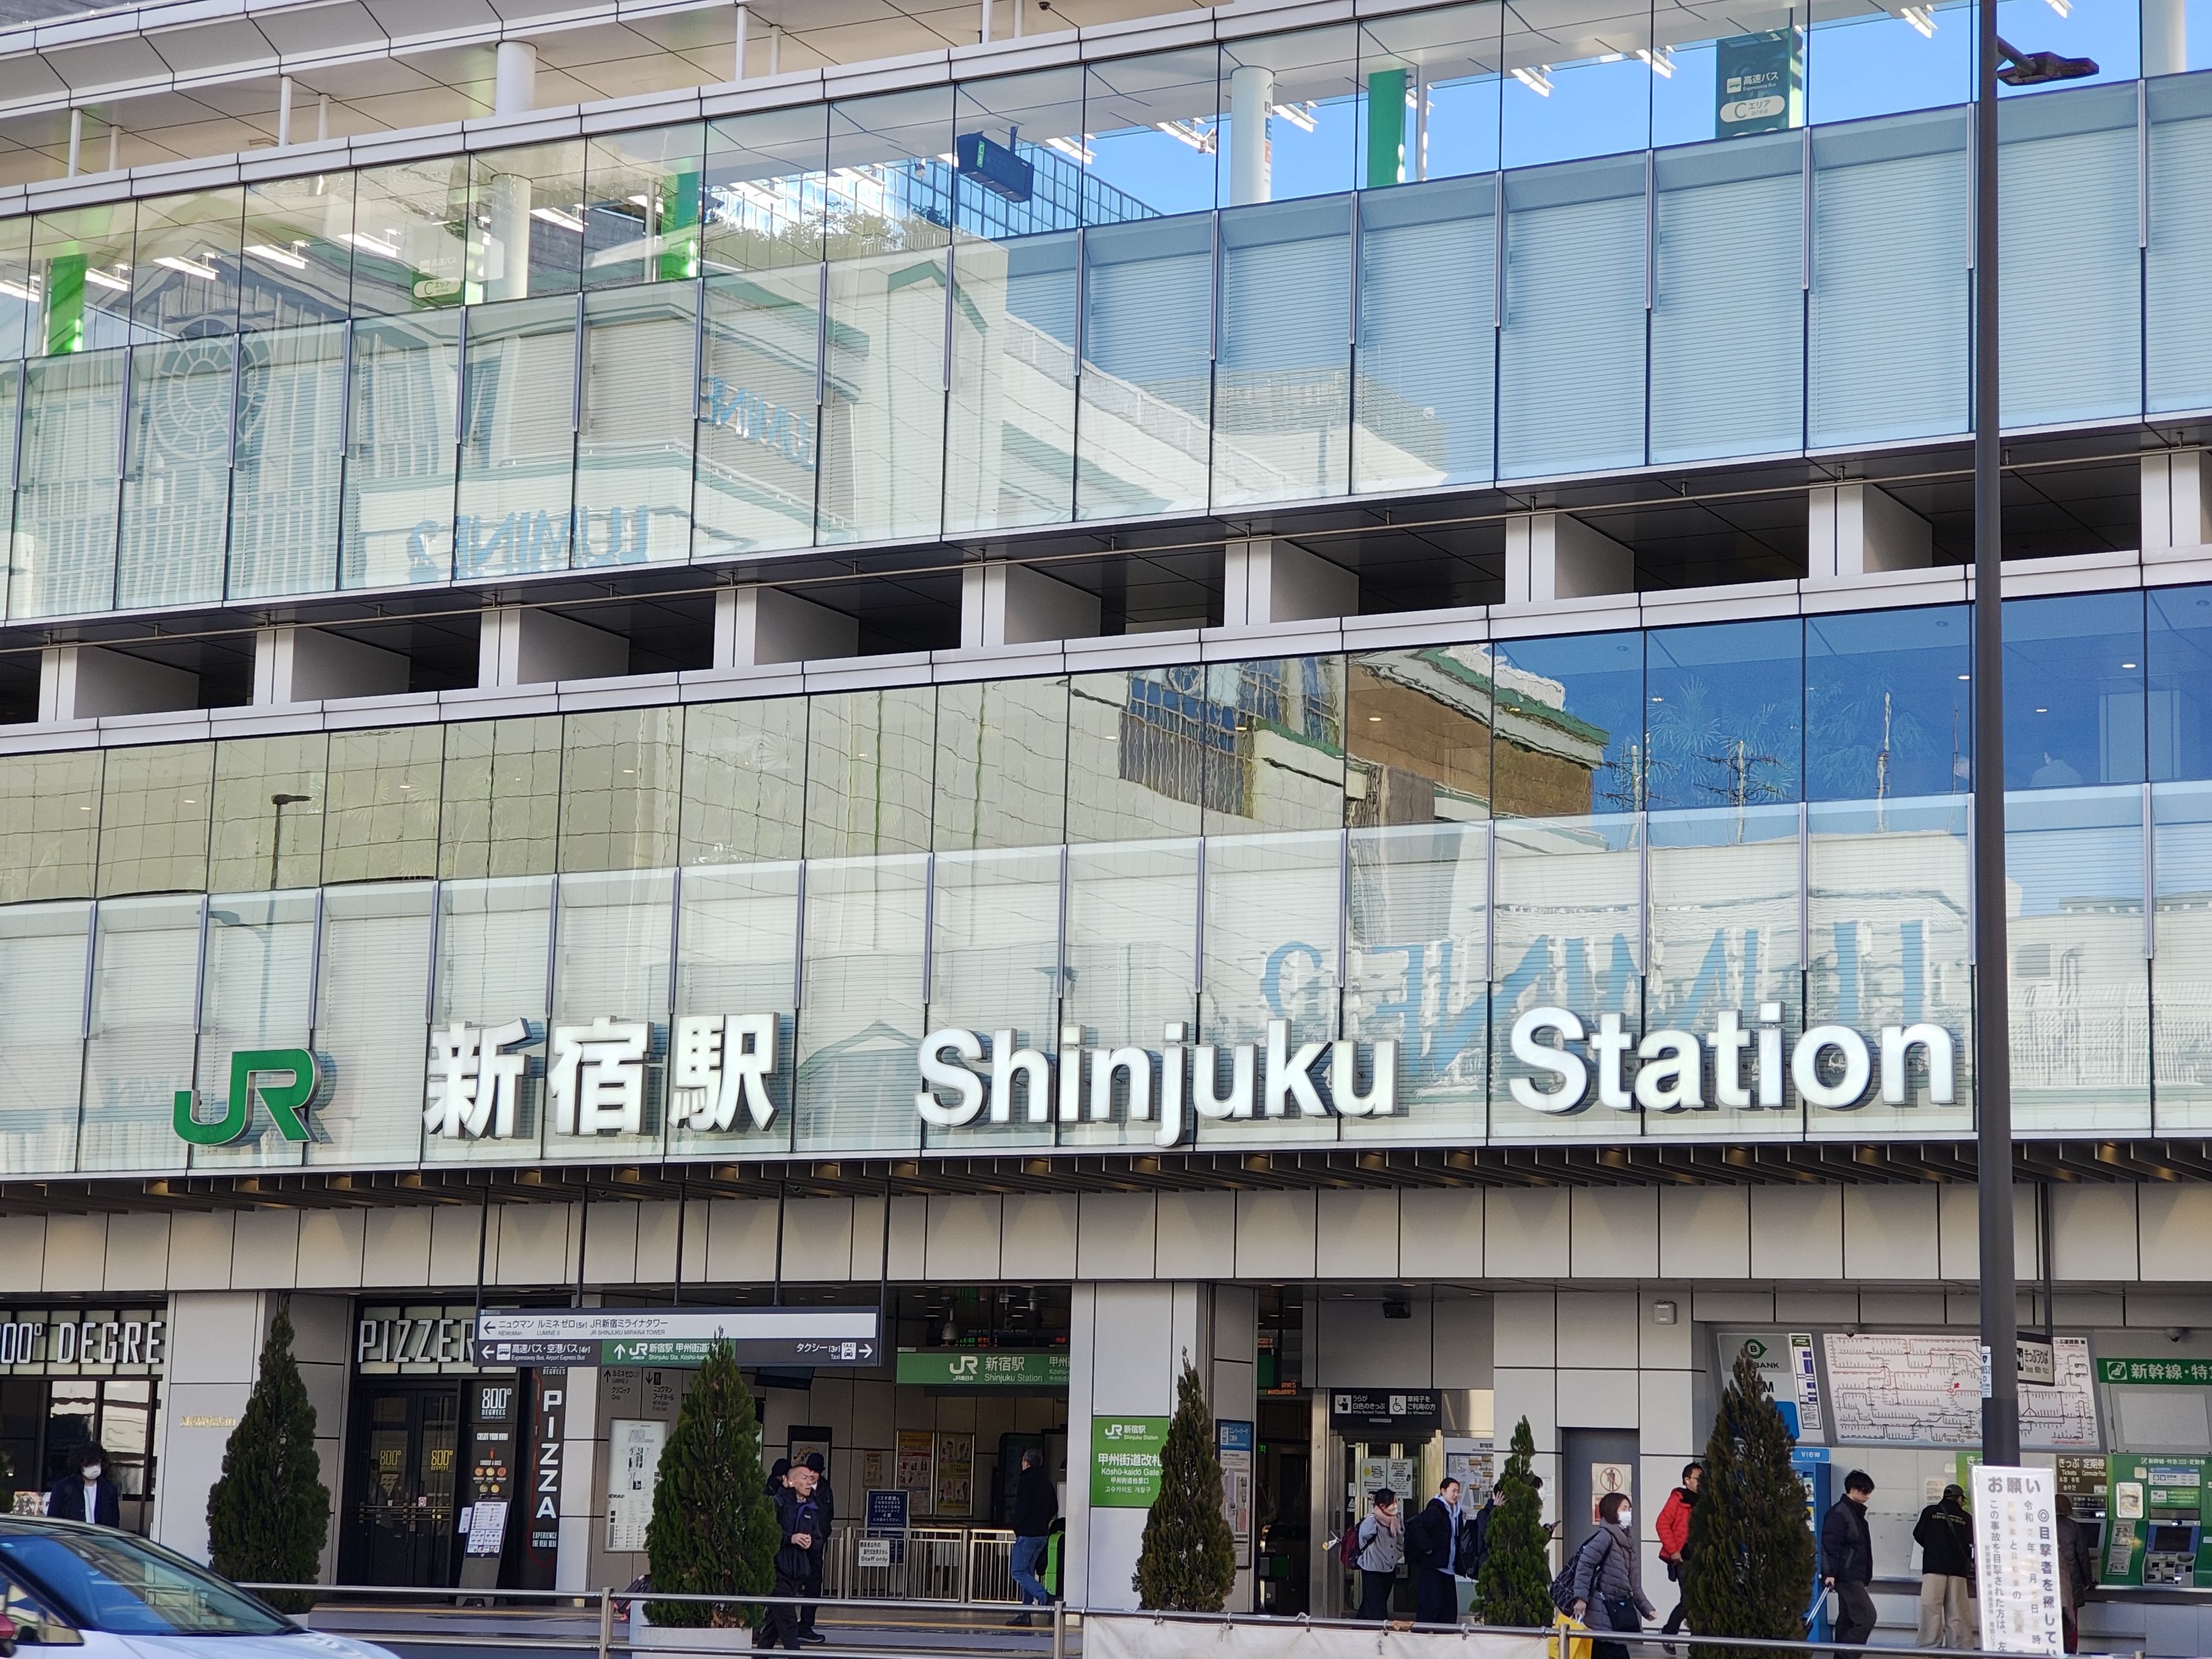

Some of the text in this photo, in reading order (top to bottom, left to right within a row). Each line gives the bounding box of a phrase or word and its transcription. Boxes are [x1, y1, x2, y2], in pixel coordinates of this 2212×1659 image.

[1743, 72, 1779, 85] 高速バス
[1734, 99, 1771, 119] C エリア
[424, 280, 451, 295] C エリア
[173, 1001, 1956, 1148] JR 新宿駅 Shinjuku Station
[498, 1320, 534, 1329] ニュウマン
[538, 1319, 559, 1329] ルミネ
[561, 1319, 575, 1328] ゼロ
[590, 1319, 668, 1329] JR新宿ミライナタワー
[0, 1322, 42, 1364] 00°
[629, 1342, 648, 1356] JR
[649, 1342, 674, 1353] 新宿駅
[796, 1342, 828, 1353] タクシー
[2024, 1349, 2049, 1364] きっぷうりば
[949, 1356, 978, 1375] JR
[985, 1356, 1025, 1372] 新宿駅
[2130, 1363, 2212, 1380] 新幹線・特
[984, 1373, 1016, 1383] Shinjuku
[1017, 1373, 1043, 1382] Station
[481, 1387, 512, 1409] 800°
[1105, 1424, 1146, 1436] JR 新宿駅
[535, 1390, 563, 1519] PIZZA
[2059, 1458, 2105, 1469] きっぷ 定期券
[1143, 1468, 1160, 1476] Gate
[1988, 1476, 2041, 1494] お願い
